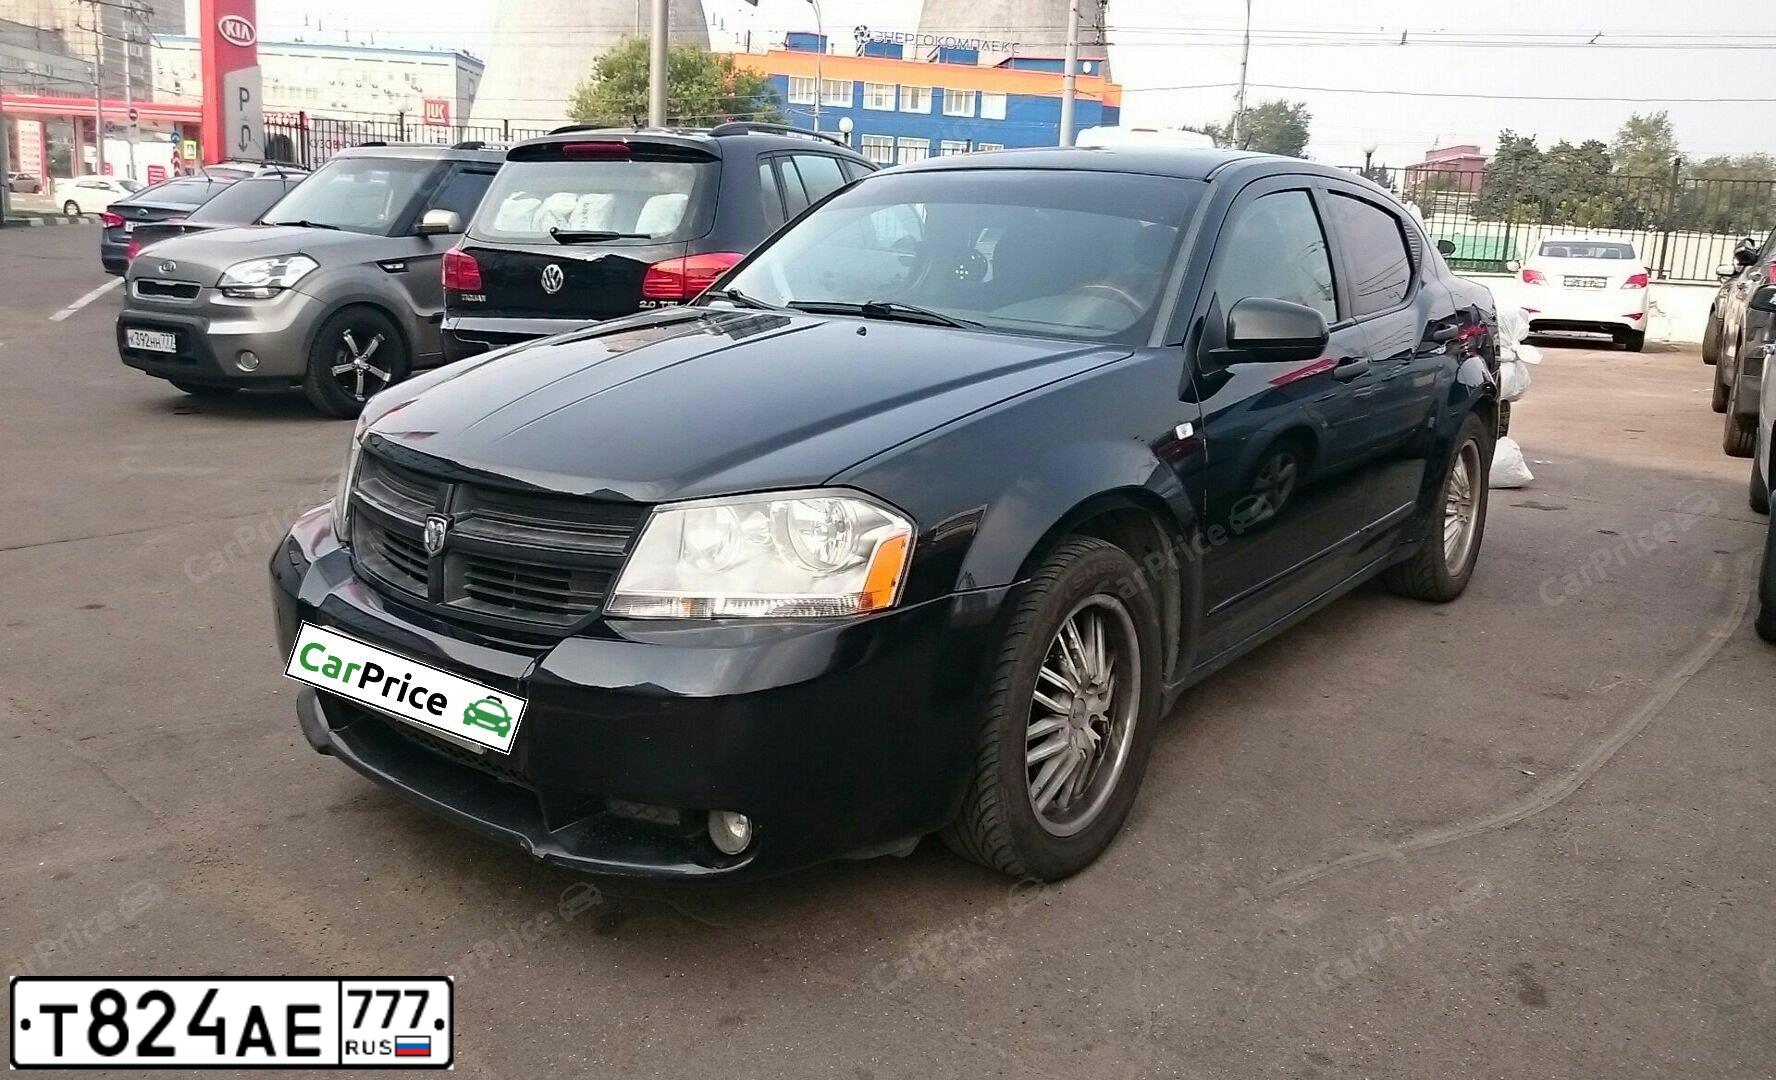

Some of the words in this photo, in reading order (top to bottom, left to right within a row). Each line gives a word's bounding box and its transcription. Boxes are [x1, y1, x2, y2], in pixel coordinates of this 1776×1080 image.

[225, 20, 251, 40] KIA
[874, 31, 1022, 54] ЭНЕРГОКОМПЛЕКС
[239, 87, 250, 111] P
